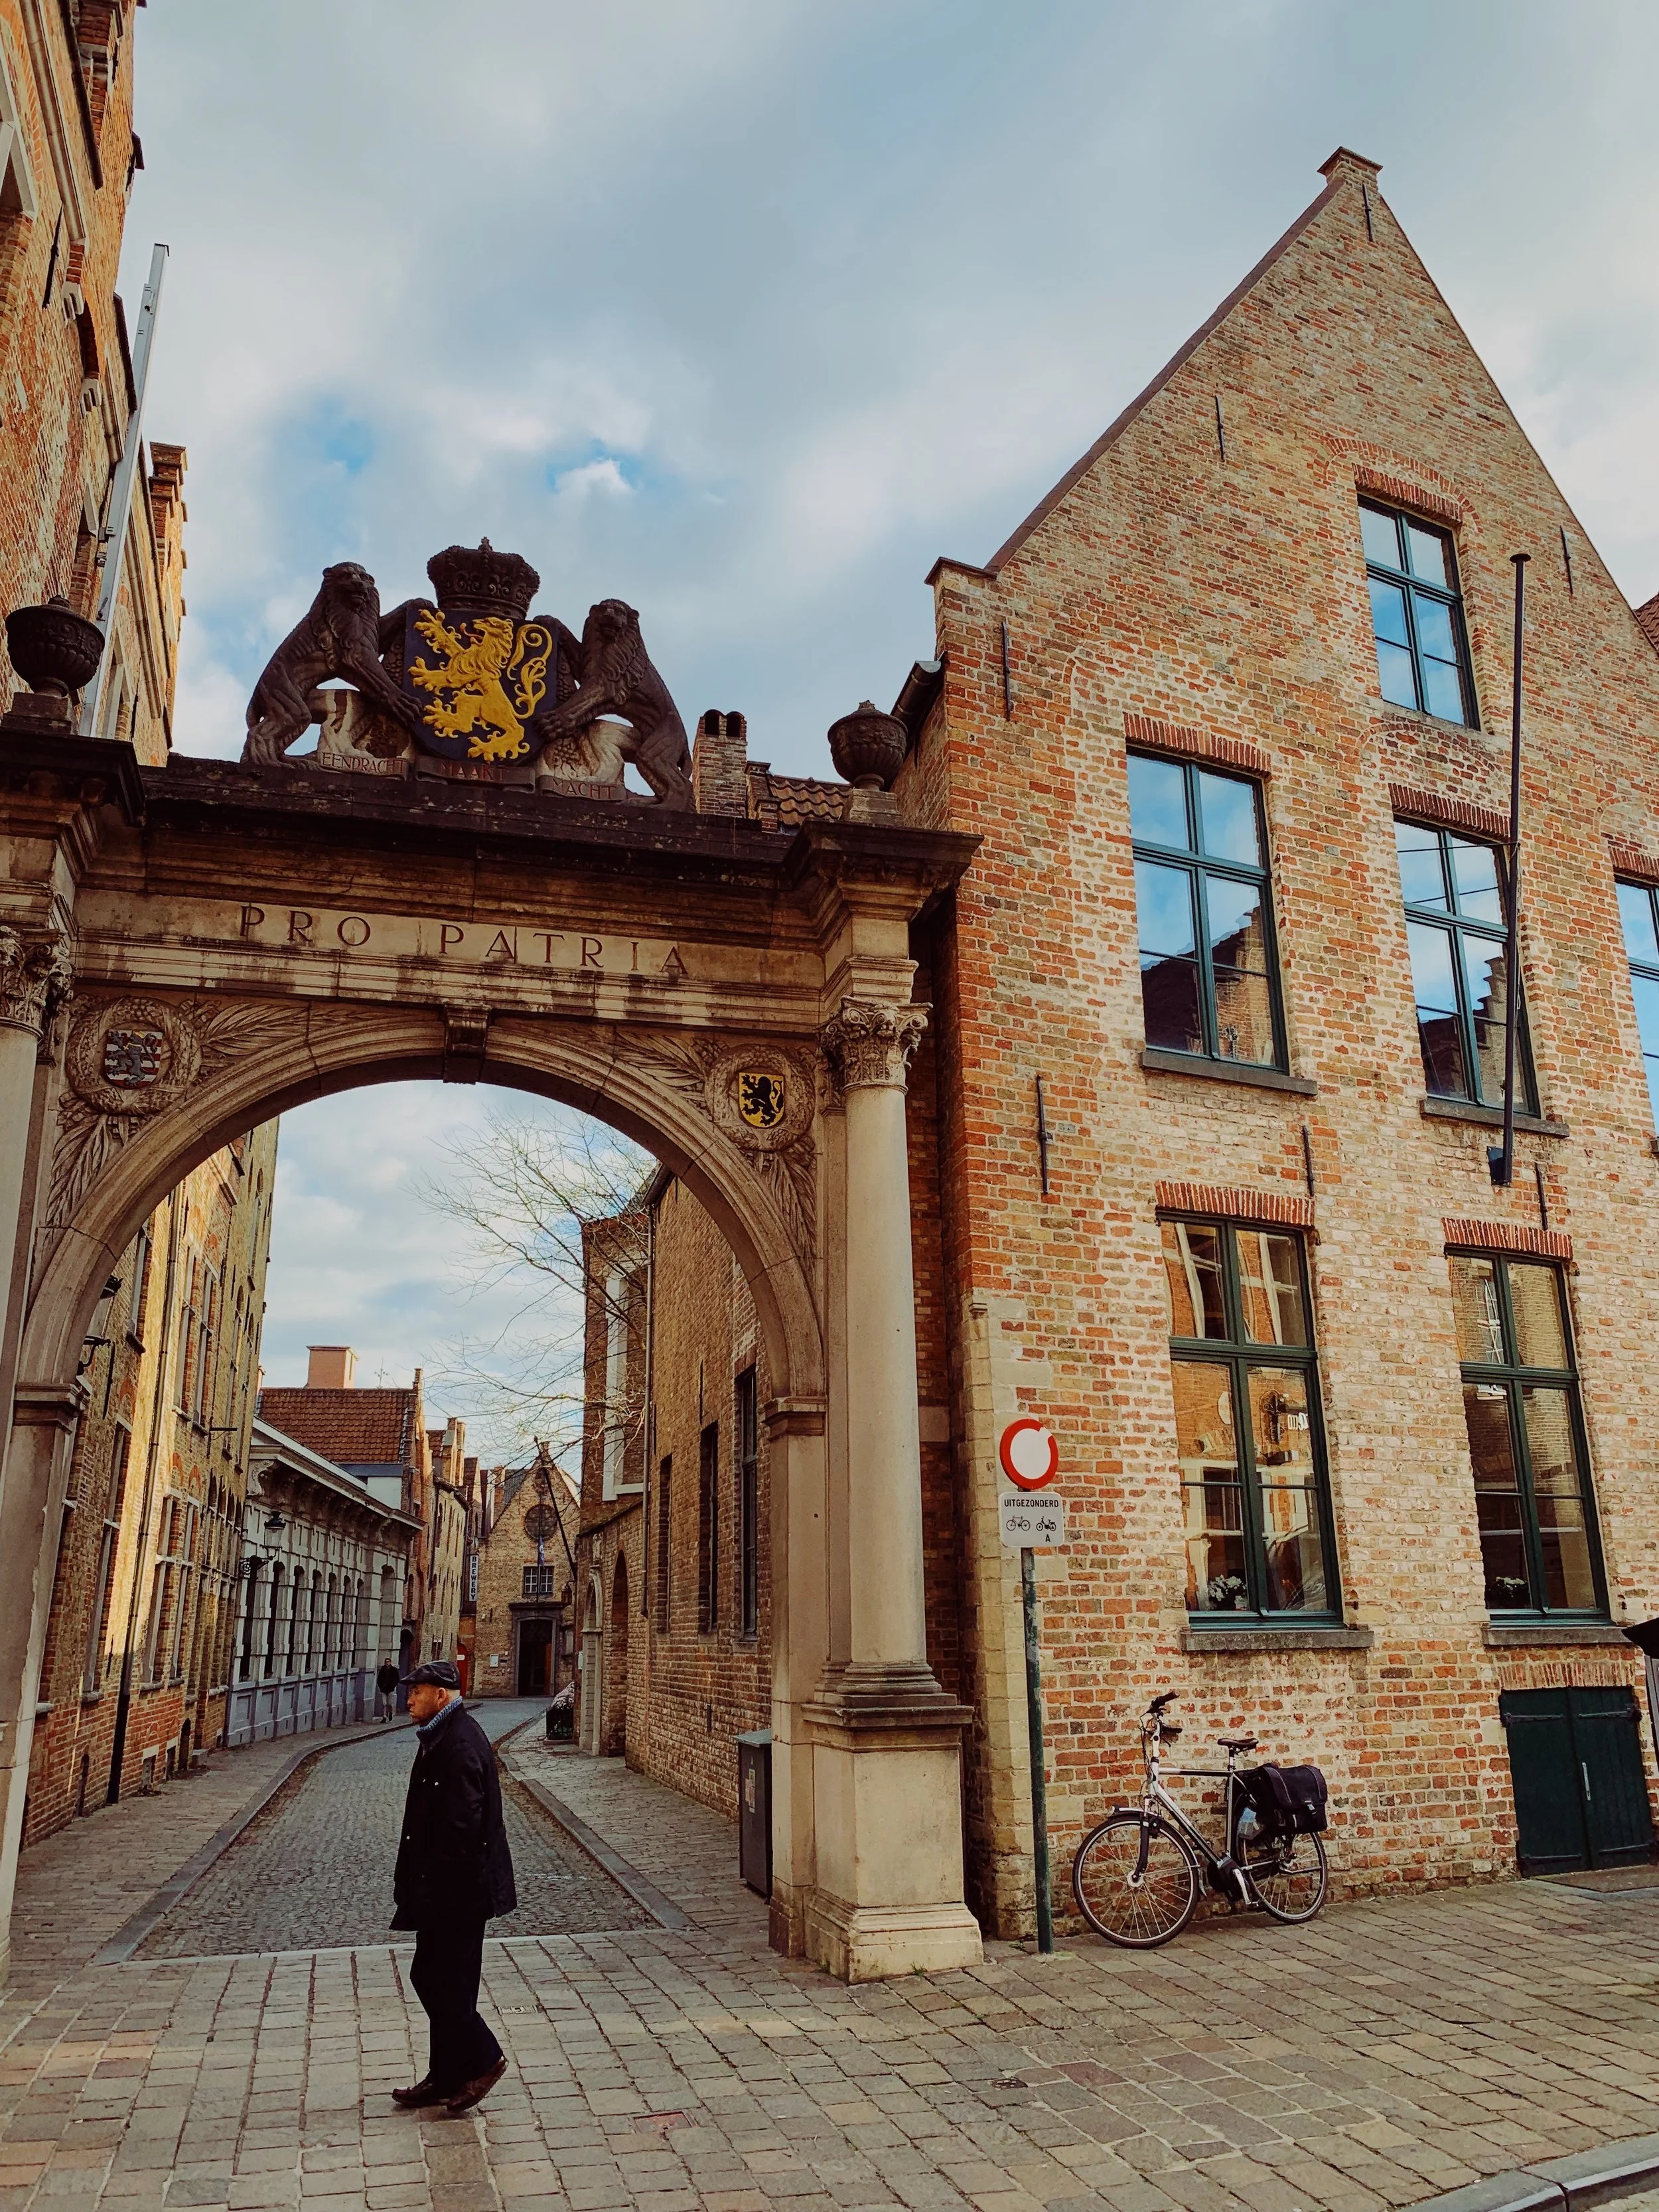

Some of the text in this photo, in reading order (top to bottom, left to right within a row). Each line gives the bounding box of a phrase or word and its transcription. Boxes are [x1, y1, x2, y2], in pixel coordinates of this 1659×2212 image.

[322, 752, 616, 800] EENDRACHT MAAKT MACHT
[240, 905, 688, 975] PRO PATRIA
[1004, 1499, 1059, 1507] UITGEZONDERD
